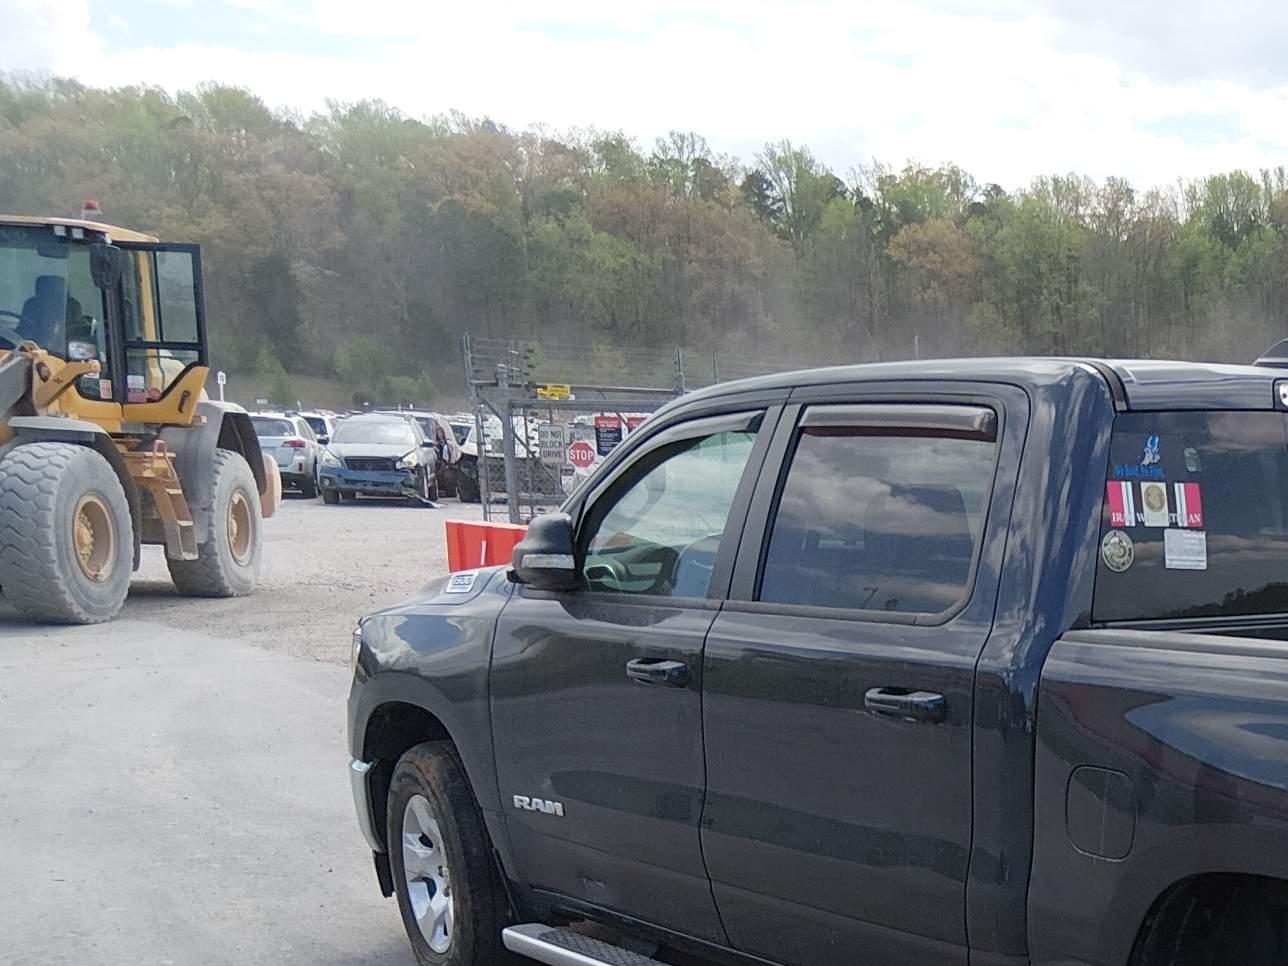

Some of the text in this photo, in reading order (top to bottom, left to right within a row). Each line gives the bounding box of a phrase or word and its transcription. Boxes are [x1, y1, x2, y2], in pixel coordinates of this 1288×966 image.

[540, 440, 563, 449] BLOCK
[569, 449, 594, 461] STOP
[513, 794, 565, 817] RAM
